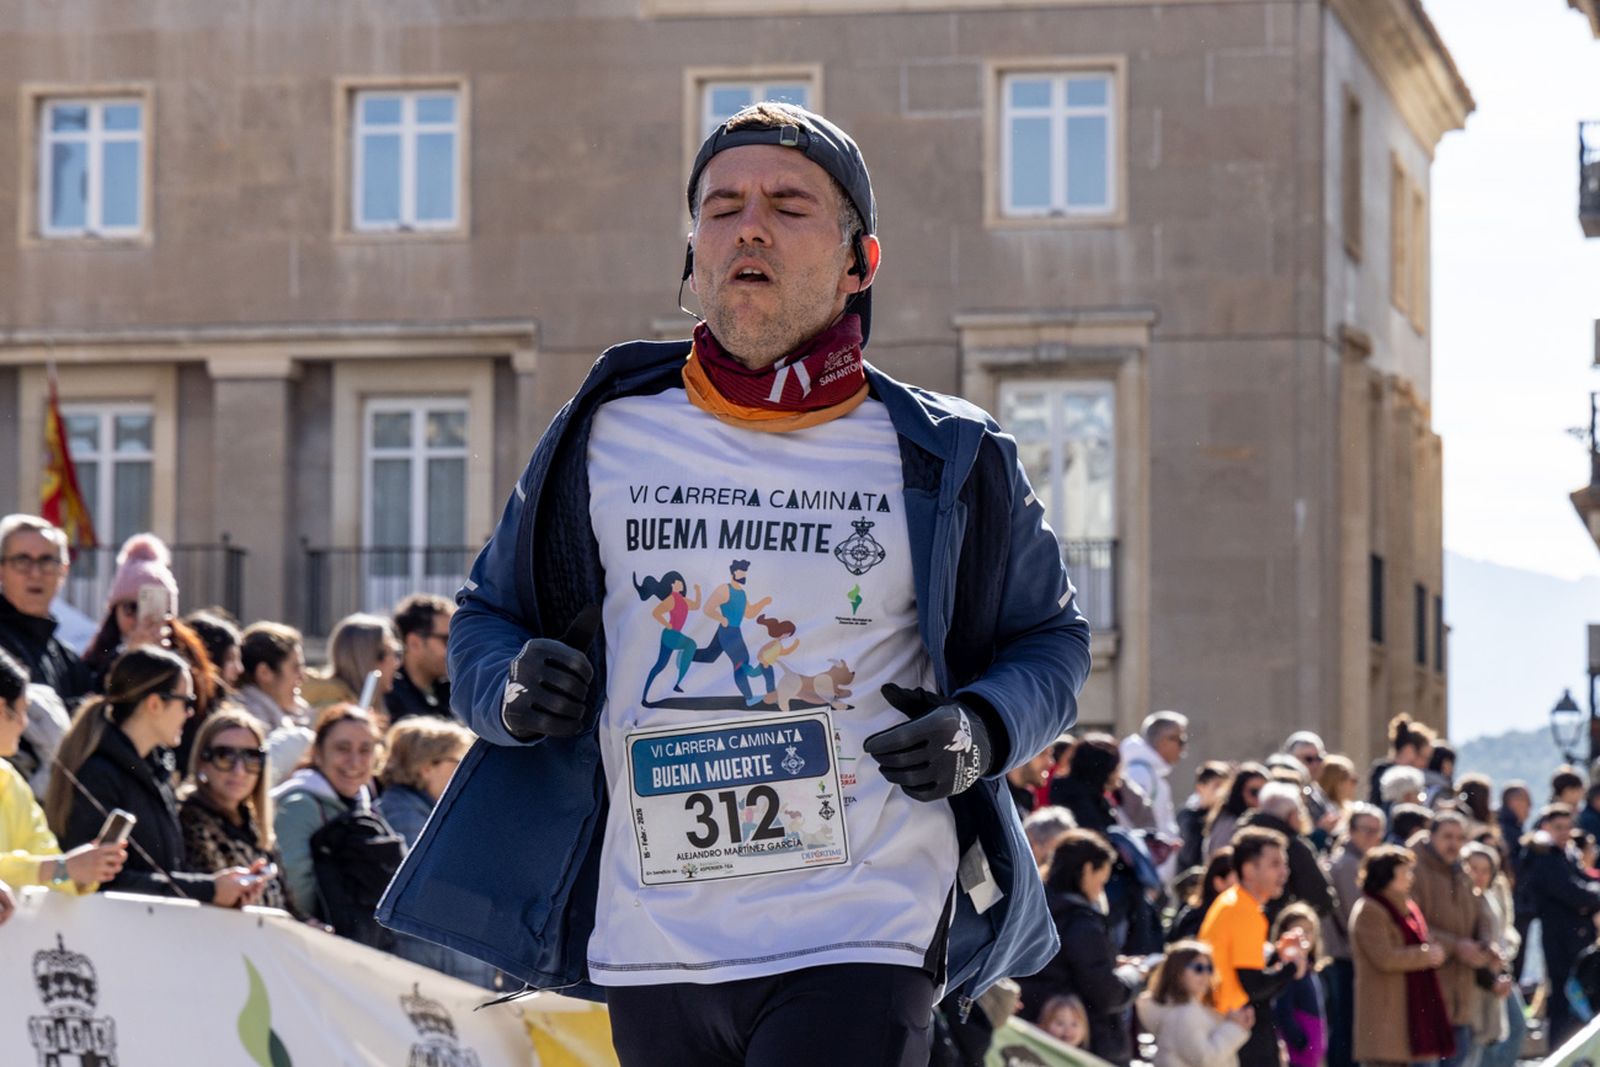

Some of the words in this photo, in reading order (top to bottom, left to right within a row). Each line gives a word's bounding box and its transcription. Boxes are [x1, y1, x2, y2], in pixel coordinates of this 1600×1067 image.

[819, 372, 837, 386] SAN
[629, 485, 648, 504] VI
[654, 485, 761, 507] CARRERA
[769, 489, 891, 513] CAMINATA
[626, 518, 708, 551] BUENA
[718, 519, 832, 553] MUERTE
[651, 744, 663, 759] VI
[665, 737, 726, 756] CARRERA
[729, 728, 803, 749] CAMINATA
[652, 763, 701, 788] BUENA
[705, 754, 774, 783] MUERTE
[685, 785, 786, 849] 312
[676, 849, 722, 861] ALEJANDRO
